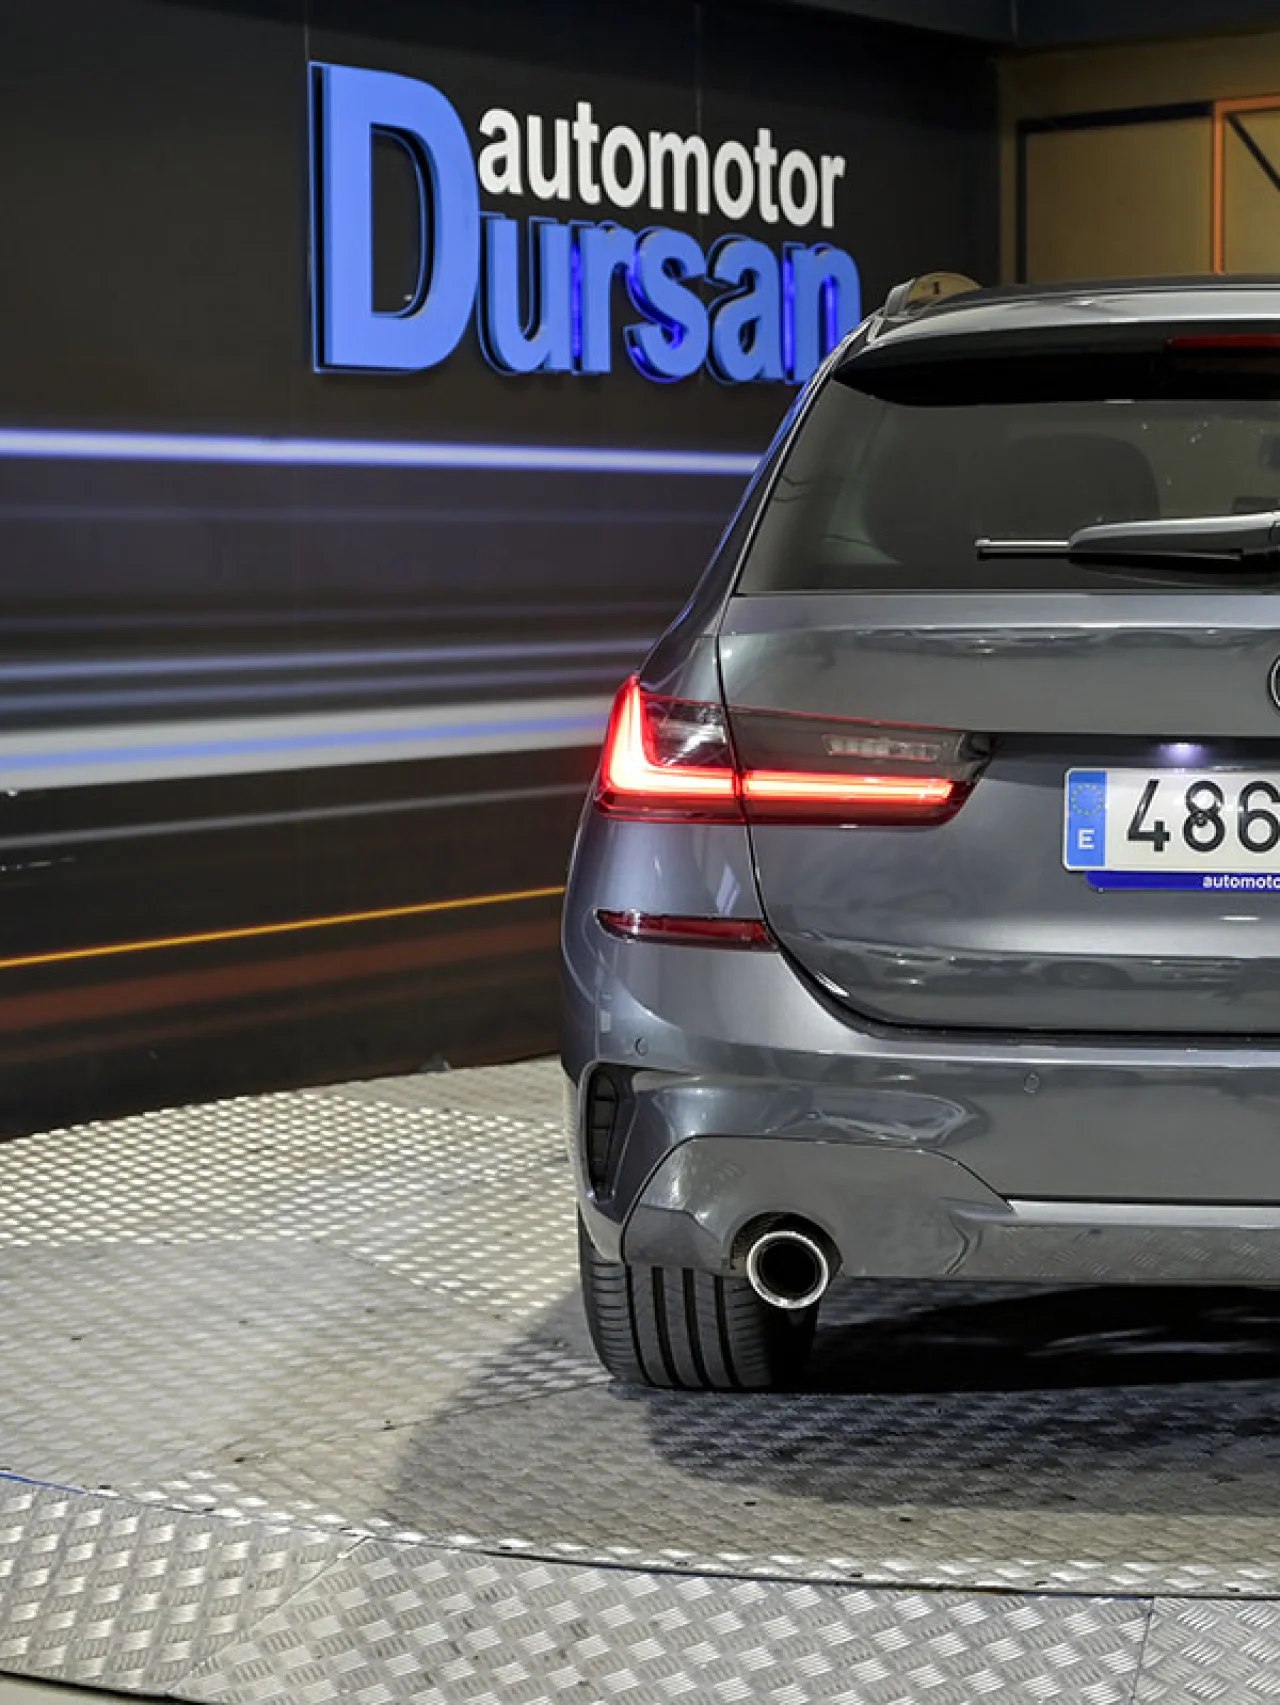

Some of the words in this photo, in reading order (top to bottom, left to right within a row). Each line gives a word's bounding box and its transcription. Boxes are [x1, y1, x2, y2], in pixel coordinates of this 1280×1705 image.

[308, 61, 862, 384] Dursan
[479, 101, 847, 229] automotor
[1078, 828, 1095, 850] E
